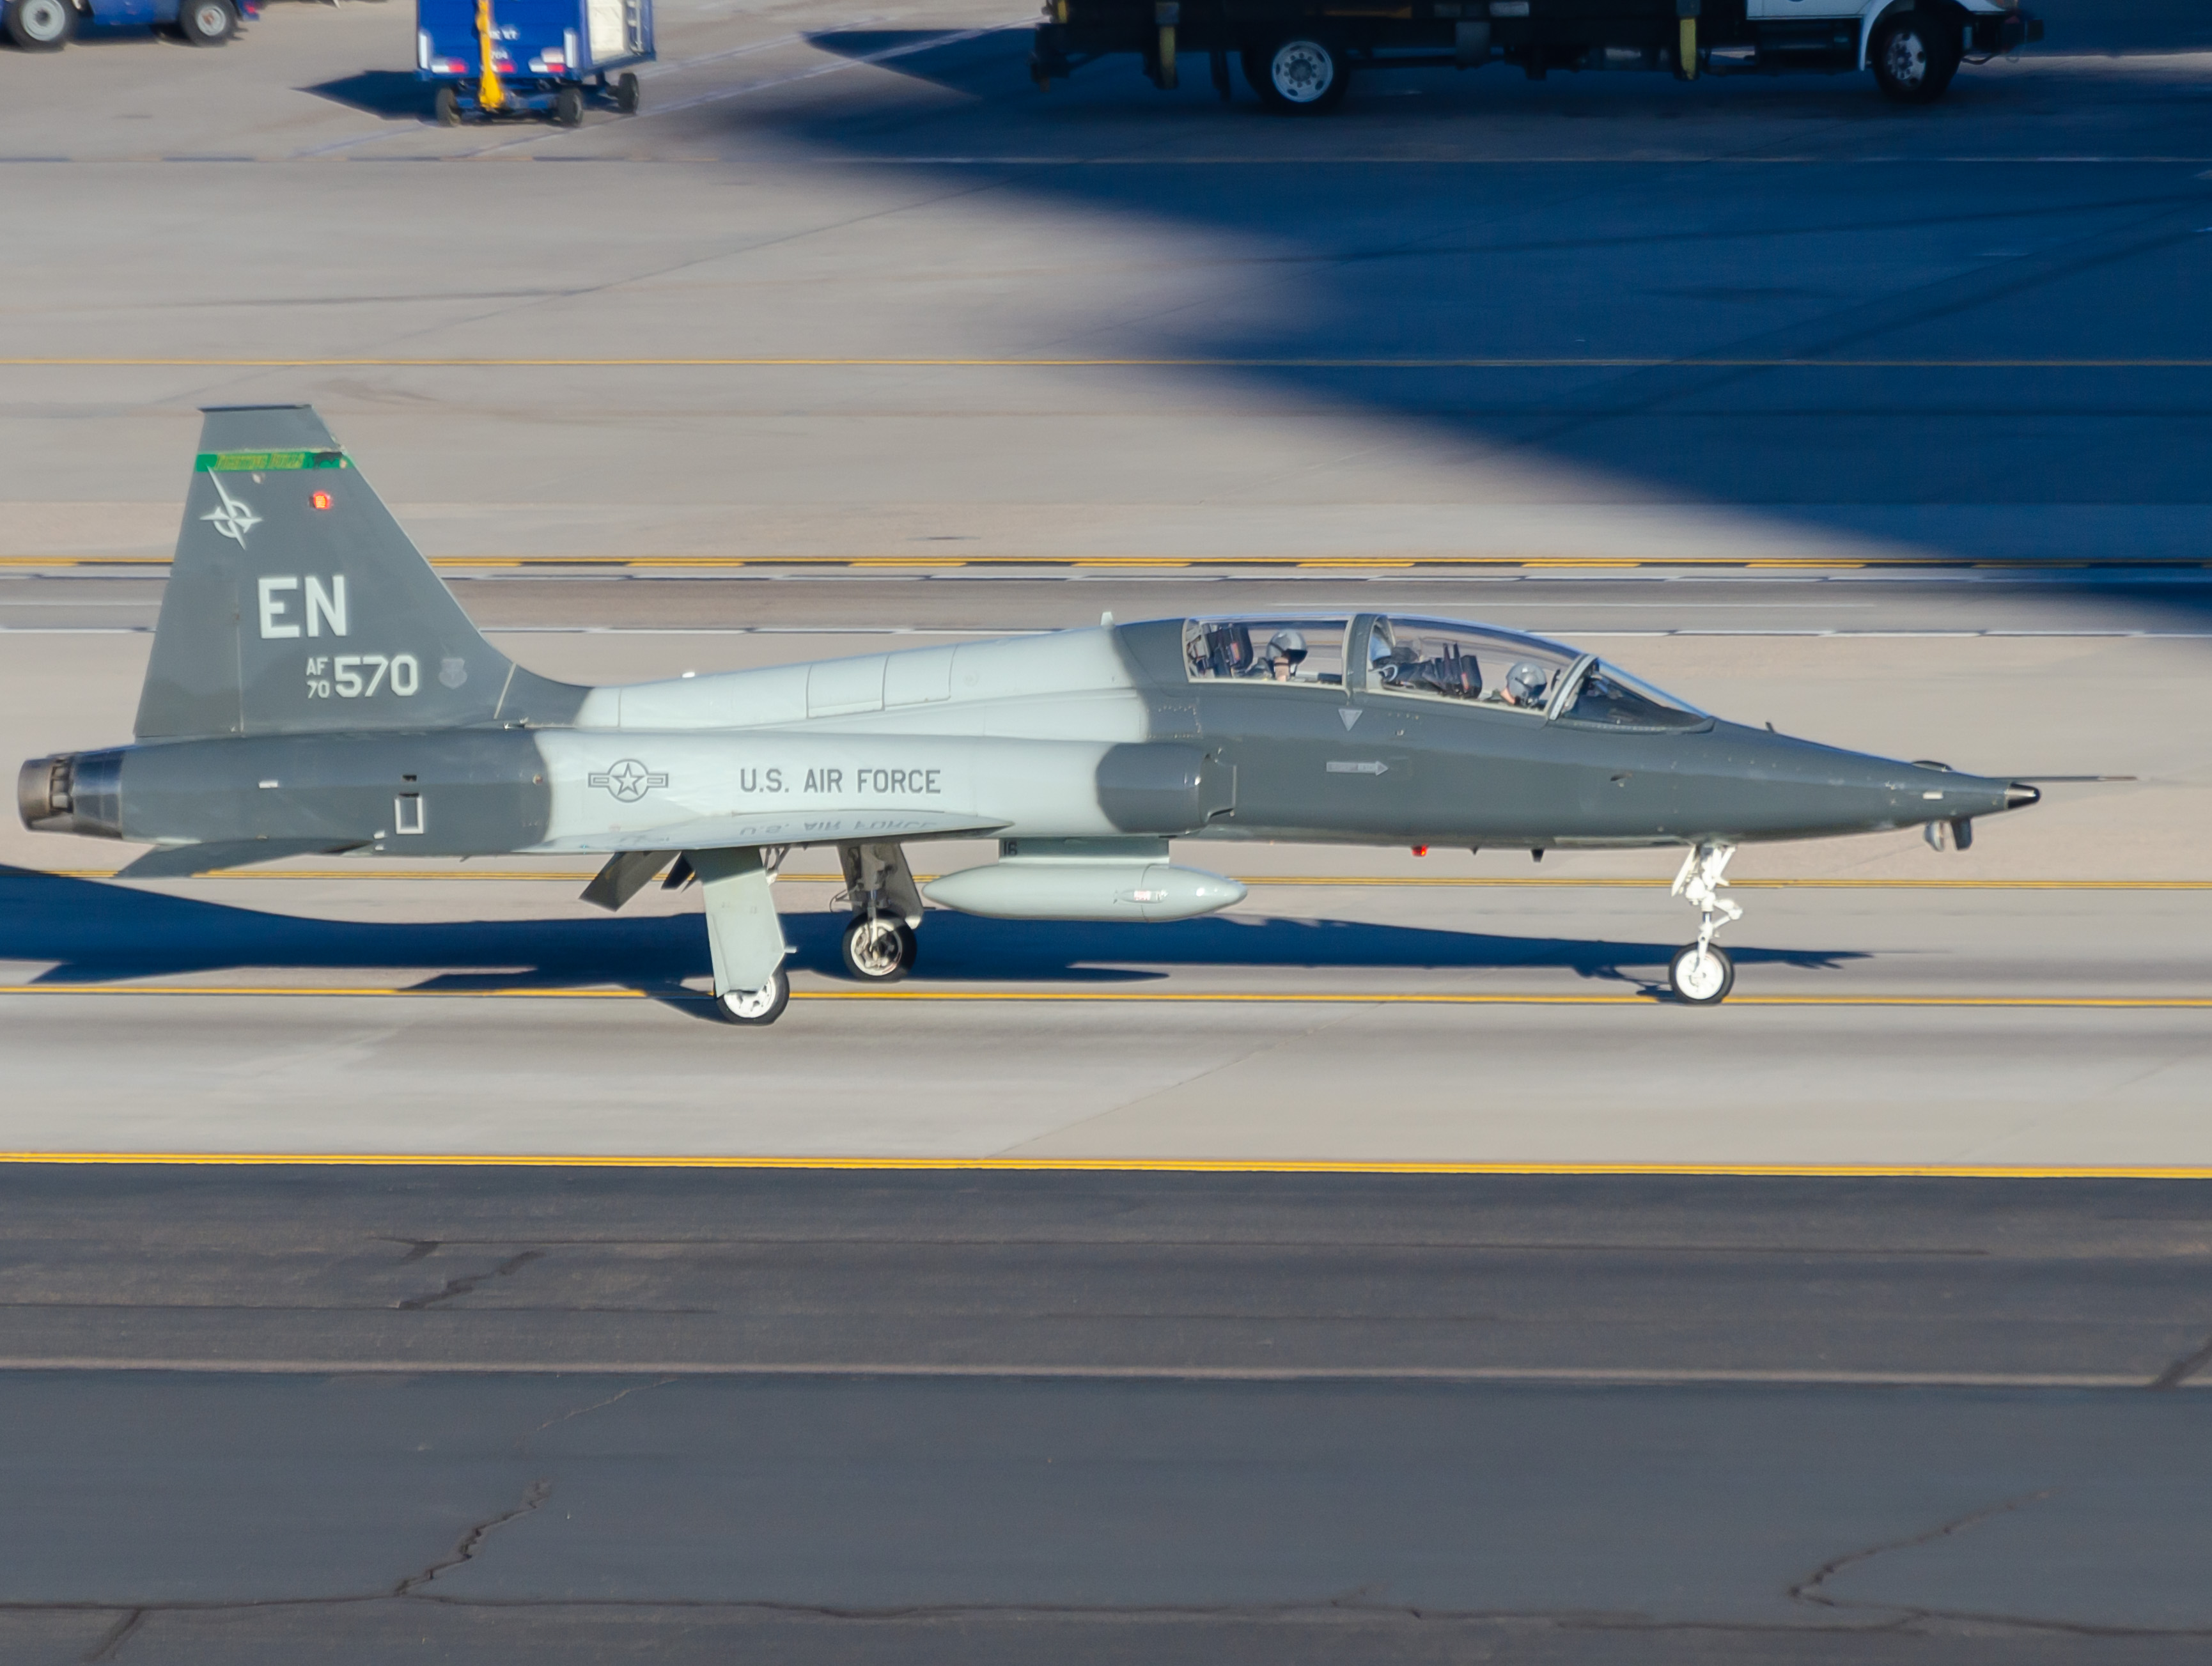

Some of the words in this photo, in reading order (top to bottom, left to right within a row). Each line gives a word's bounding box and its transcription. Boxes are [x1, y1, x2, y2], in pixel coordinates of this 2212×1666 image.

[258, 575, 347, 639] EN
[306, 657, 329, 676] AF
[334, 655, 419, 698] 570
[307, 680, 330, 699] 70
[740, 768, 790, 793] U.S.
[803, 768, 843, 794] AIR
[857, 769, 941, 794] FORCE
